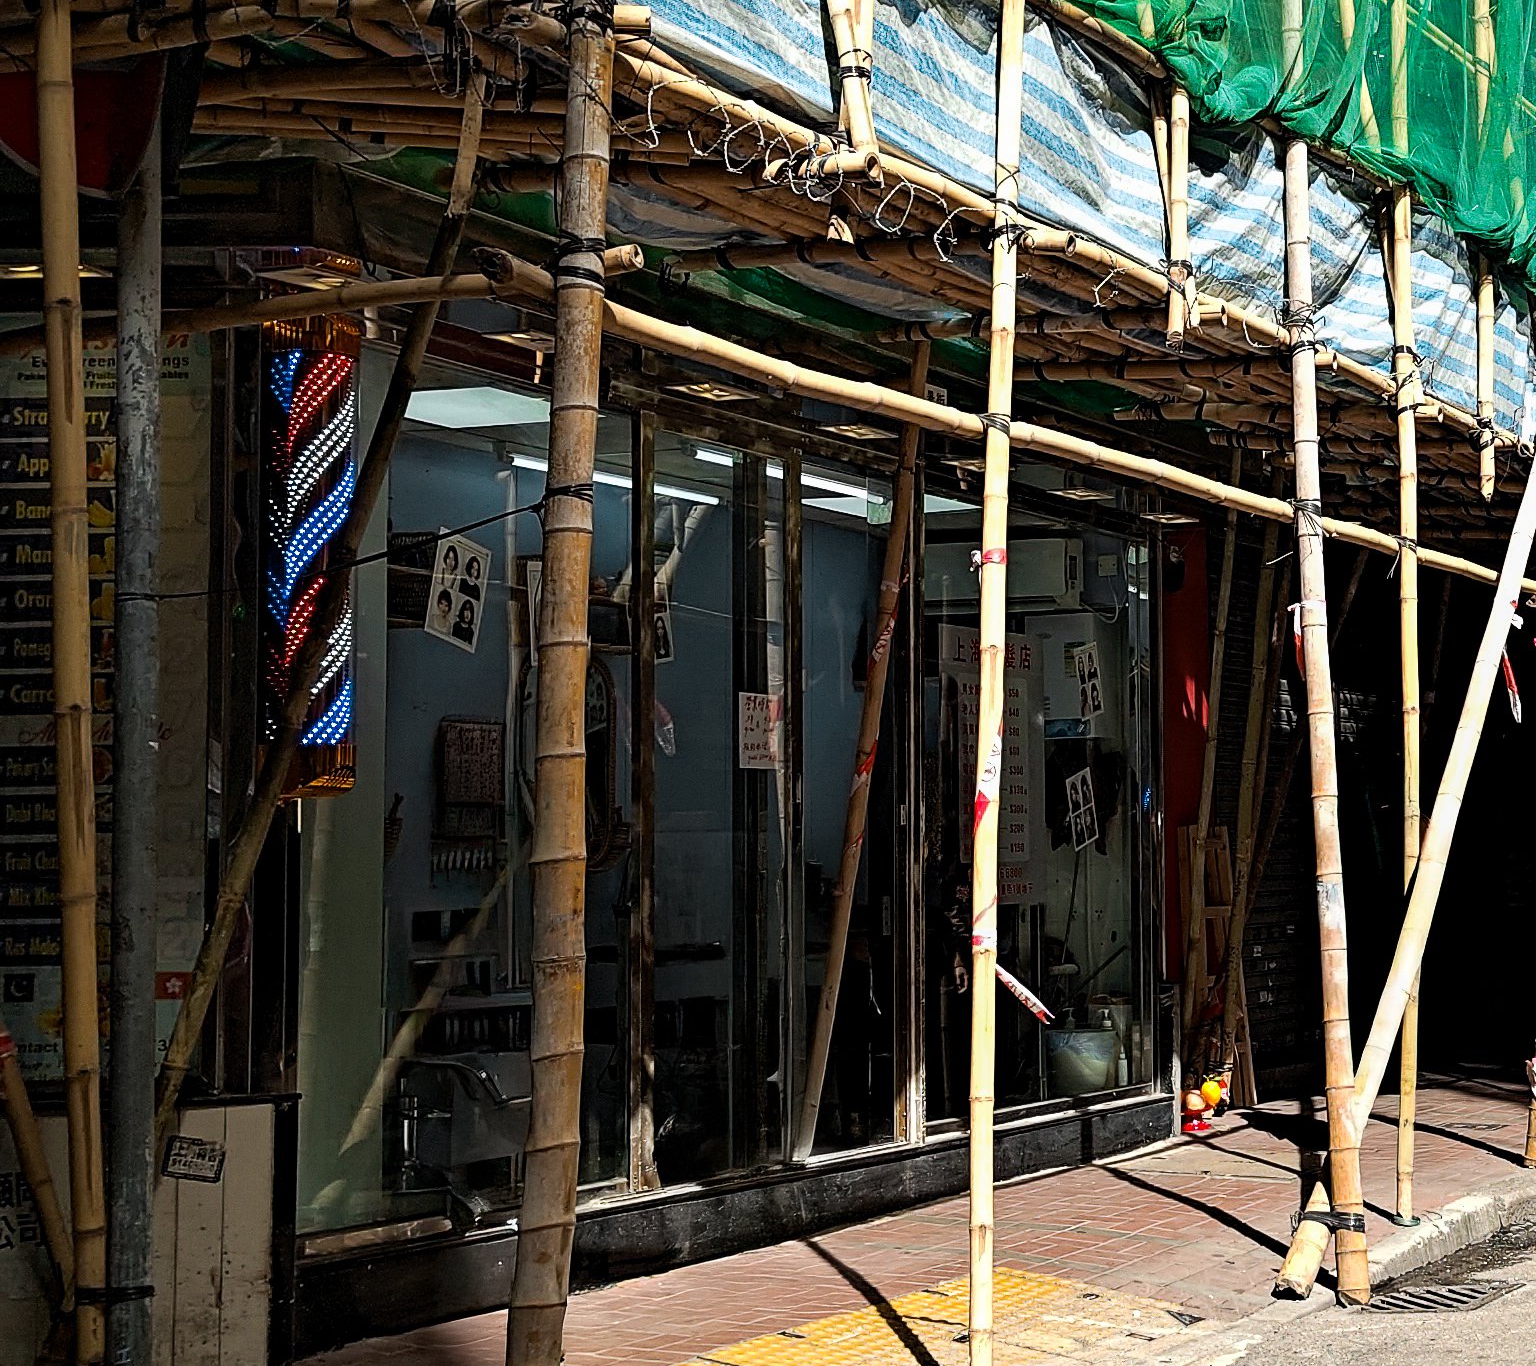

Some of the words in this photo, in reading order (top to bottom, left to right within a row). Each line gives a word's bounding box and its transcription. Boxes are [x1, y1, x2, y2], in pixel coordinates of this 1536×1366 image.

[12, 406, 110, 431] Strarry
[17, 452, 49, 478] App
[15, 499, 52, 520] Ban
[15, 544, 52, 564] Man
[15, 589, 53, 609] Ora
[953, 636, 1031, 671] 上海髮店
[17, 1042, 59, 1053] ntact
